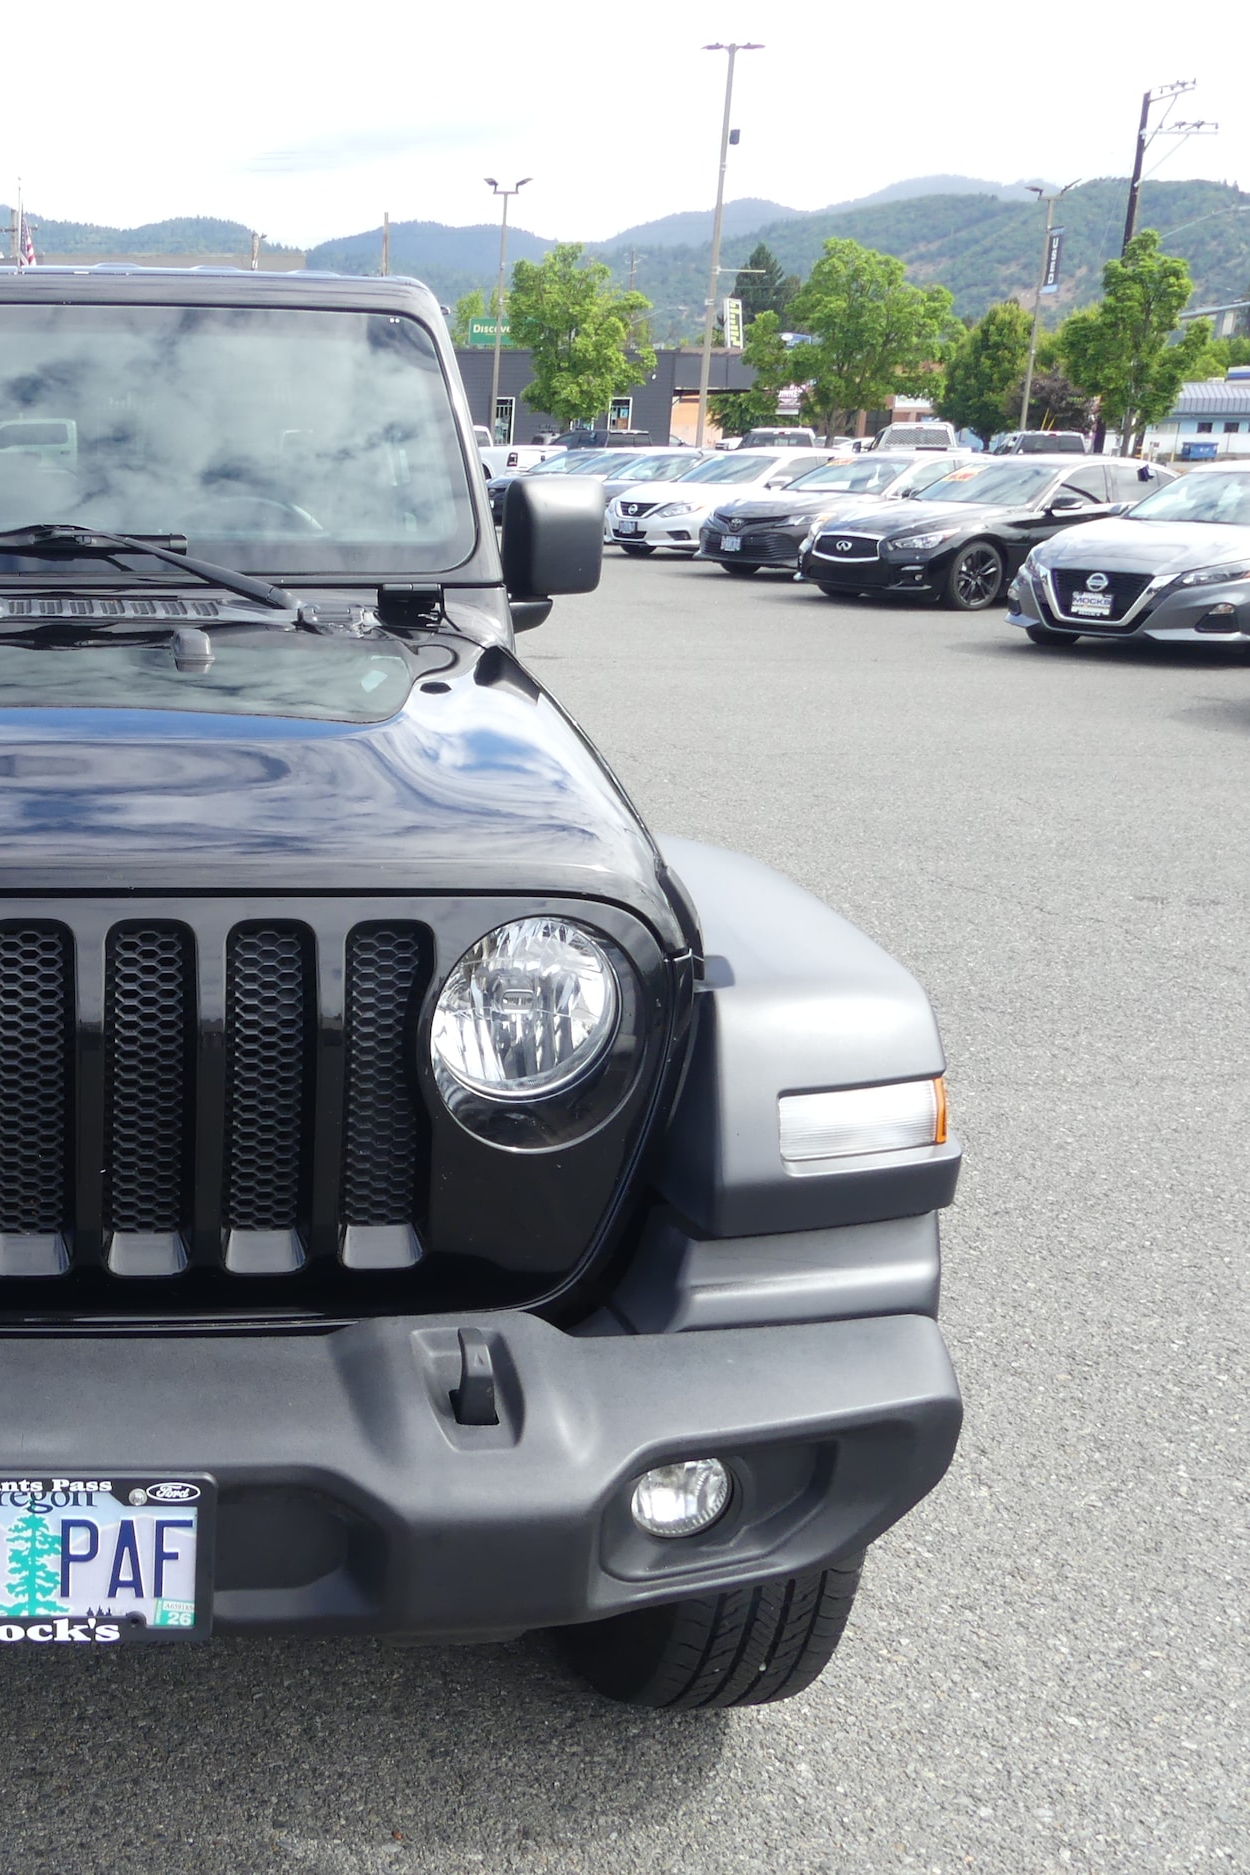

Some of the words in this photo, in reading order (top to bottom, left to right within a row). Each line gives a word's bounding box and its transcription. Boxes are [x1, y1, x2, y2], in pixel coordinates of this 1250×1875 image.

[1048, 237, 1059, 284] USED
[52, 1478, 112, 1492] Pass
[156, 1485, 190, 1498] Ford
[60, 1519, 193, 1598] PAF
[167, 1612, 192, 1626] 26
